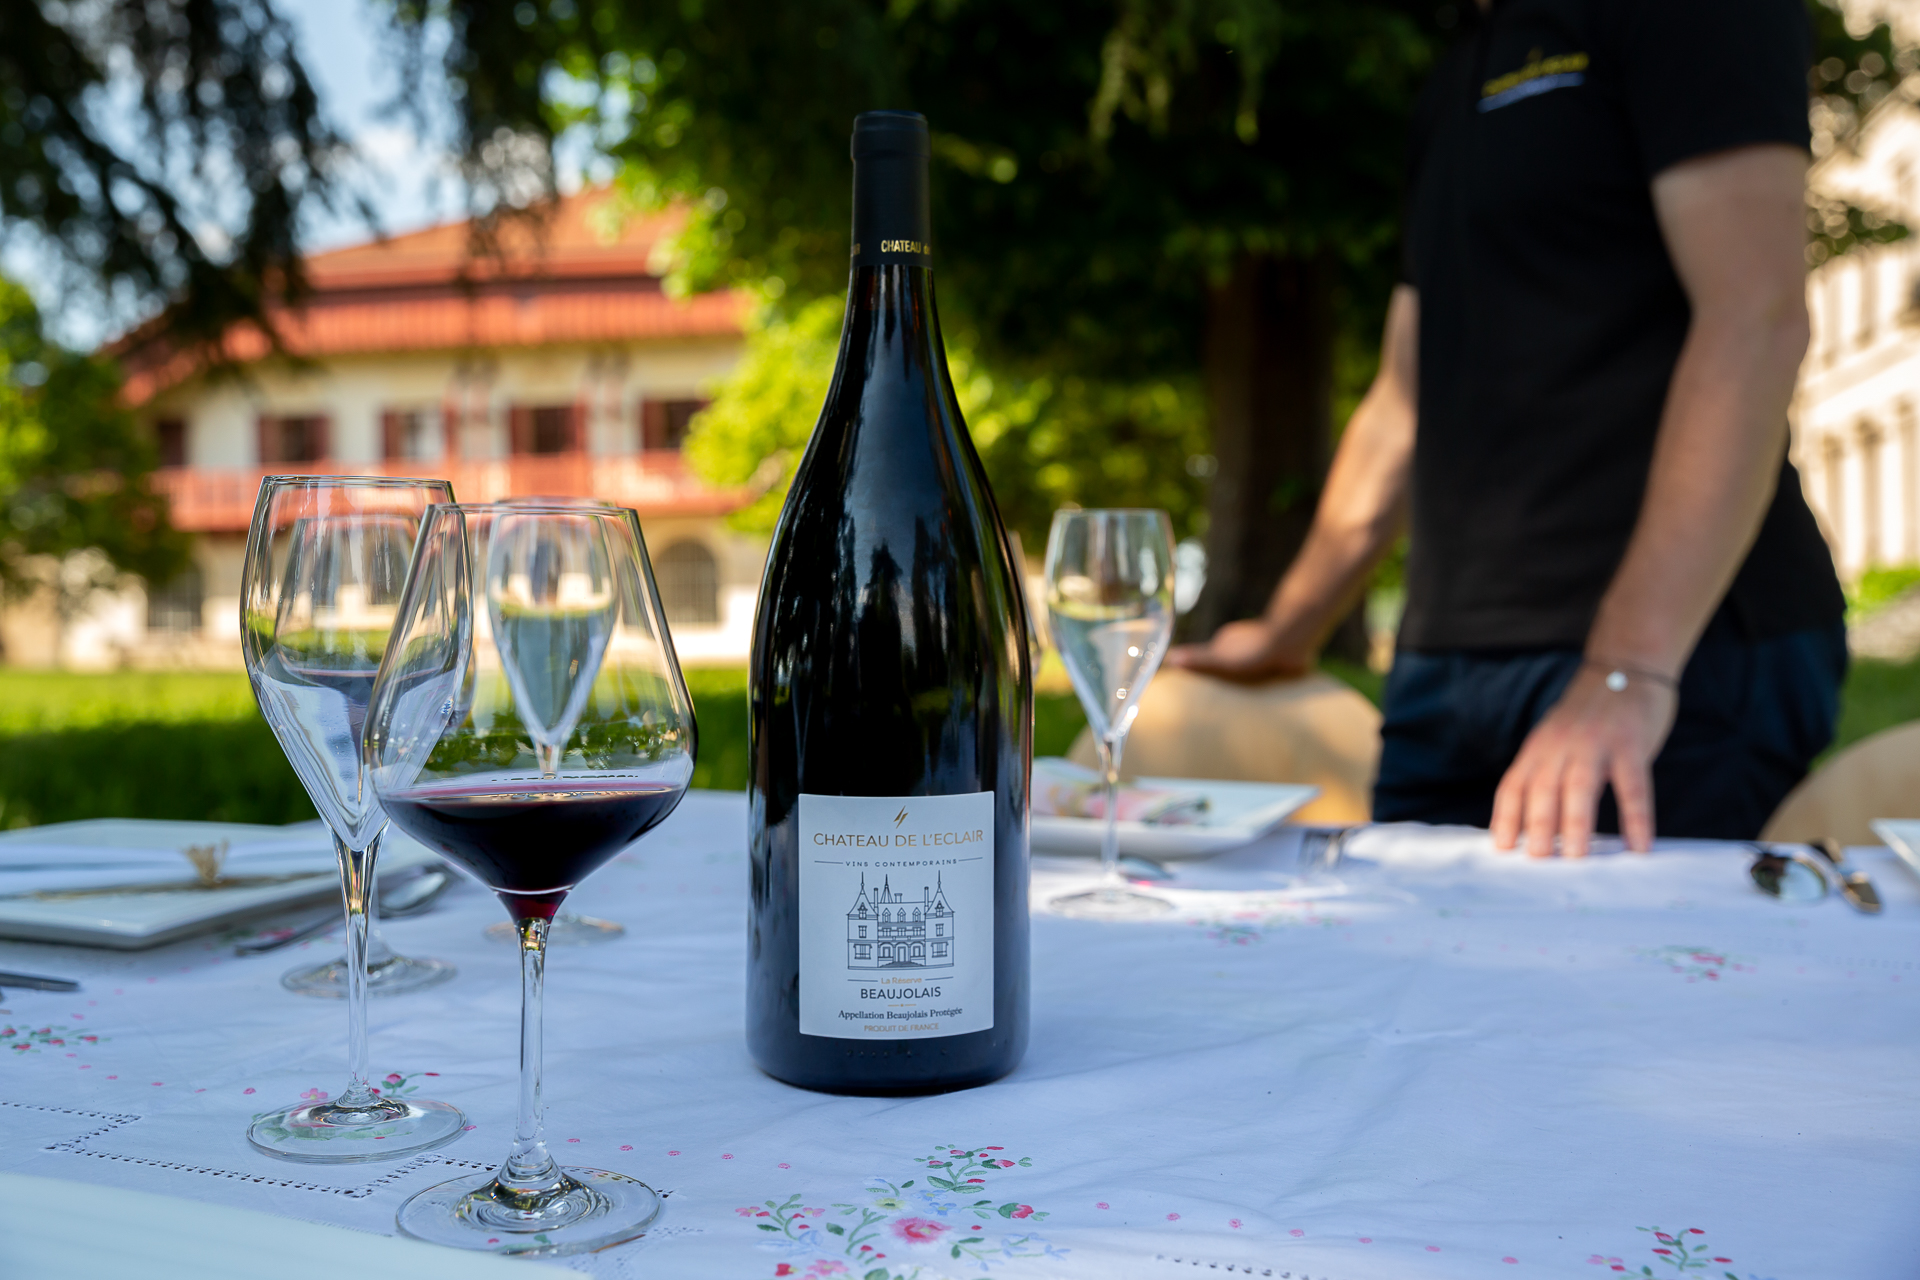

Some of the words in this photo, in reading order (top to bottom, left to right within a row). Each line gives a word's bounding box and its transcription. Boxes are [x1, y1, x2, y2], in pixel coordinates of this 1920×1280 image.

[881, 240, 921, 253] CHATEAU
[813, 833, 889, 847] CHATEAU
[895, 834, 917, 847] DE
[875, 858, 957, 867] CONTEMPORAINS
[892, 976, 922, 984] Réserve
[860, 986, 942, 999] BEAUJOLAIS
[838, 1010, 884, 1020] Appellation
[886, 1009, 928, 1021] Beaujolais
[930, 1007, 963, 1018] Protégée
[898, 1024, 909, 1032] DE
[910, 1022, 939, 1031] FRANCE
